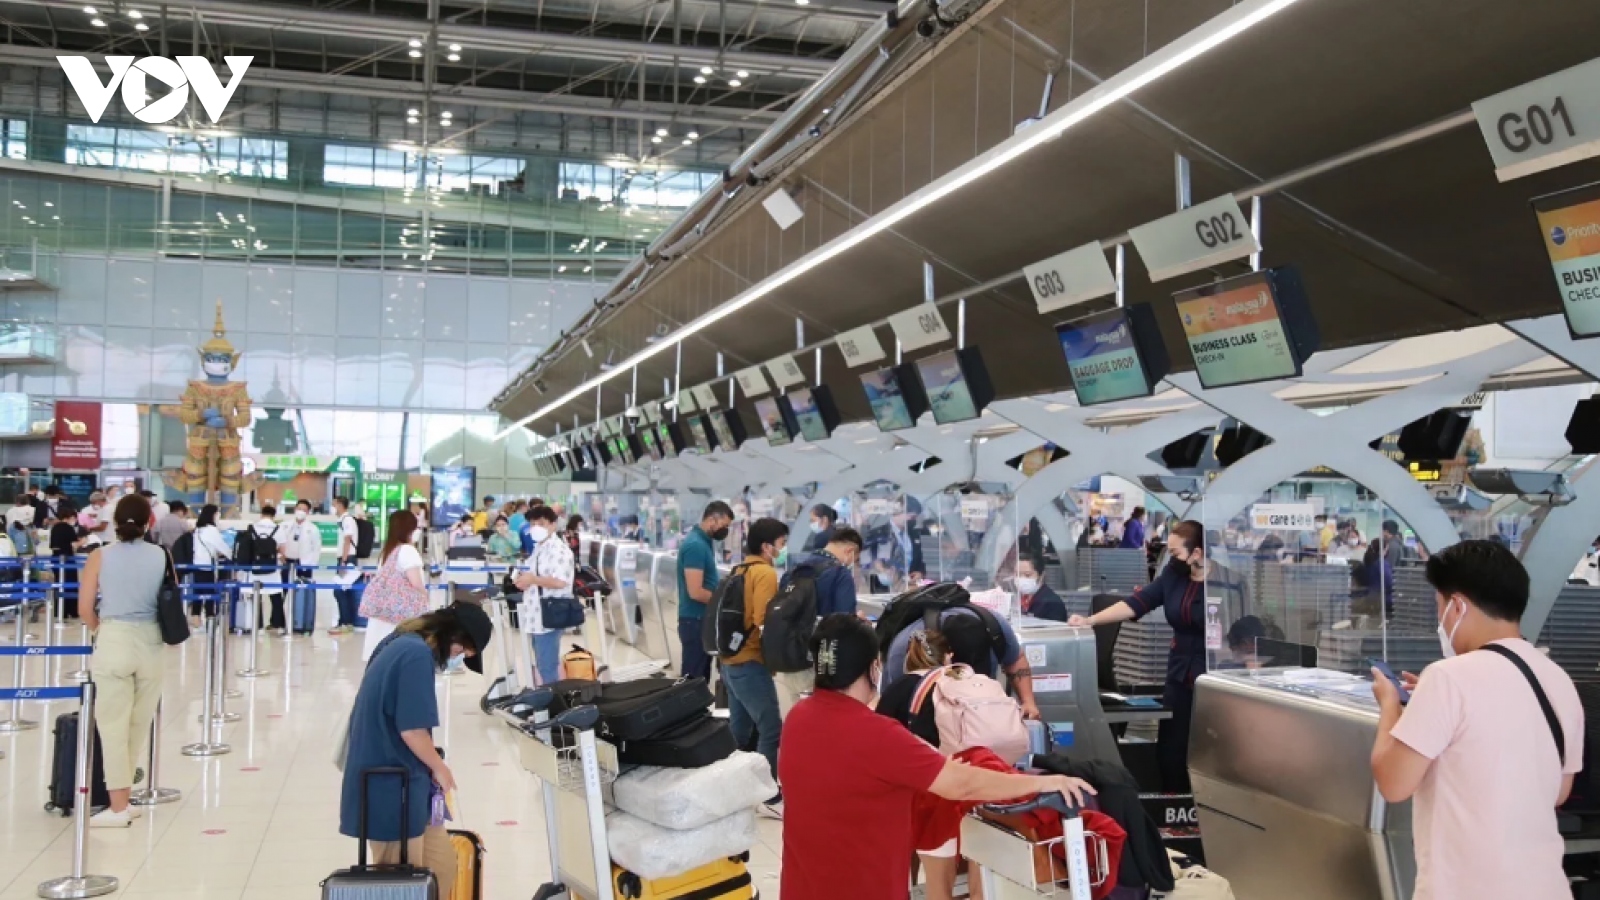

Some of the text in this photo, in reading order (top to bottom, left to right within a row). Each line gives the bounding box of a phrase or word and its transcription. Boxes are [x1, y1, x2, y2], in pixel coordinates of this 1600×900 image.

[1497, 96, 1576, 152] G01
[1195, 211, 1243, 248] G02
[1034, 270, 1065, 298] G03
[918, 311, 941, 334] G04
[1192, 337, 1230, 354] BUSINESS
[1229, 332, 1257, 347] CLASS
[1073, 356, 1134, 378] BAGGAGE DROP
[1197, 352, 1225, 365] CHECK-IN
[1270, 514, 1288, 525] care
[15, 689, 40, 697] AOT
